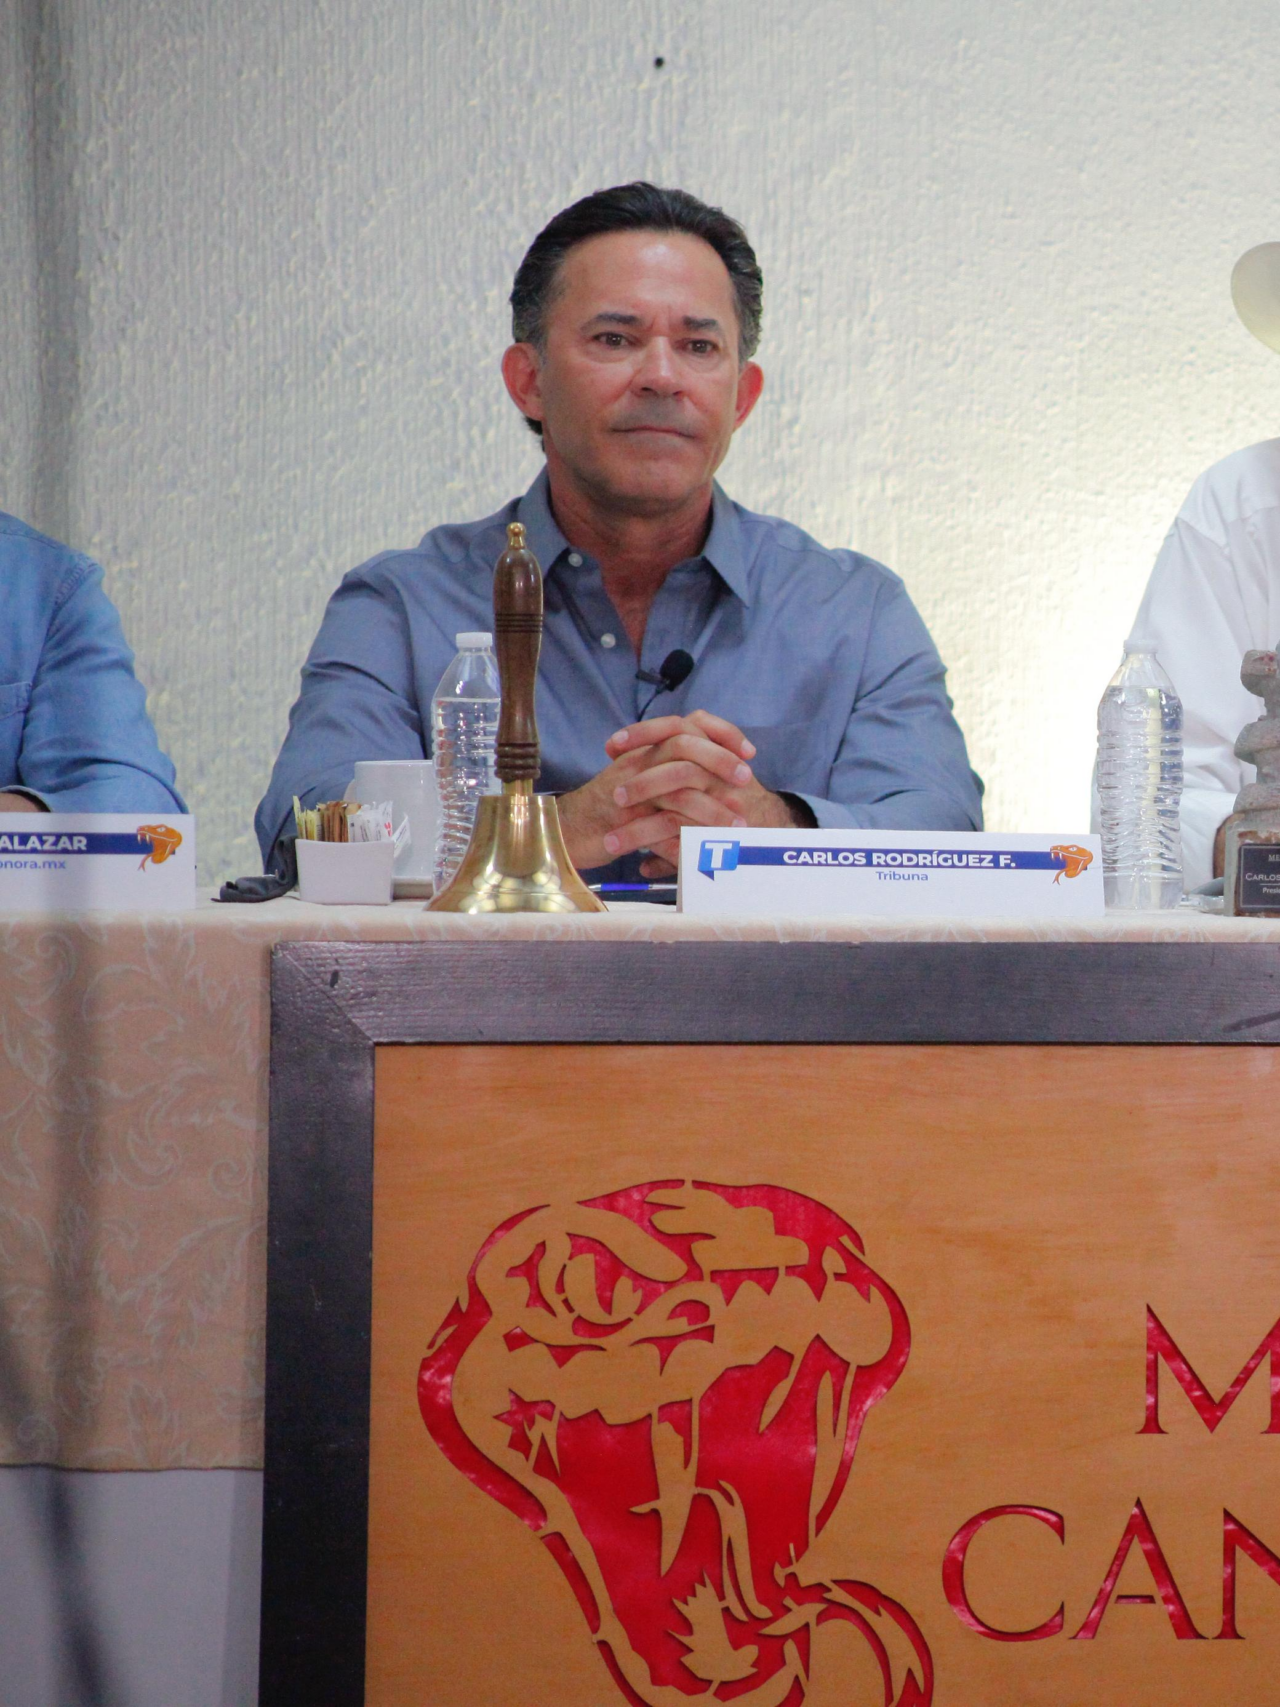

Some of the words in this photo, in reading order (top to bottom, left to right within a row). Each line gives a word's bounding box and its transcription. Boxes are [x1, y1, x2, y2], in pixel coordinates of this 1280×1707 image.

[782, 850, 866, 865] CARLOS
[872, 850, 994, 867] RODRÍGUEZ
[999, 855, 1016, 867] F.
[875, 871, 929, 881] Tribuna
